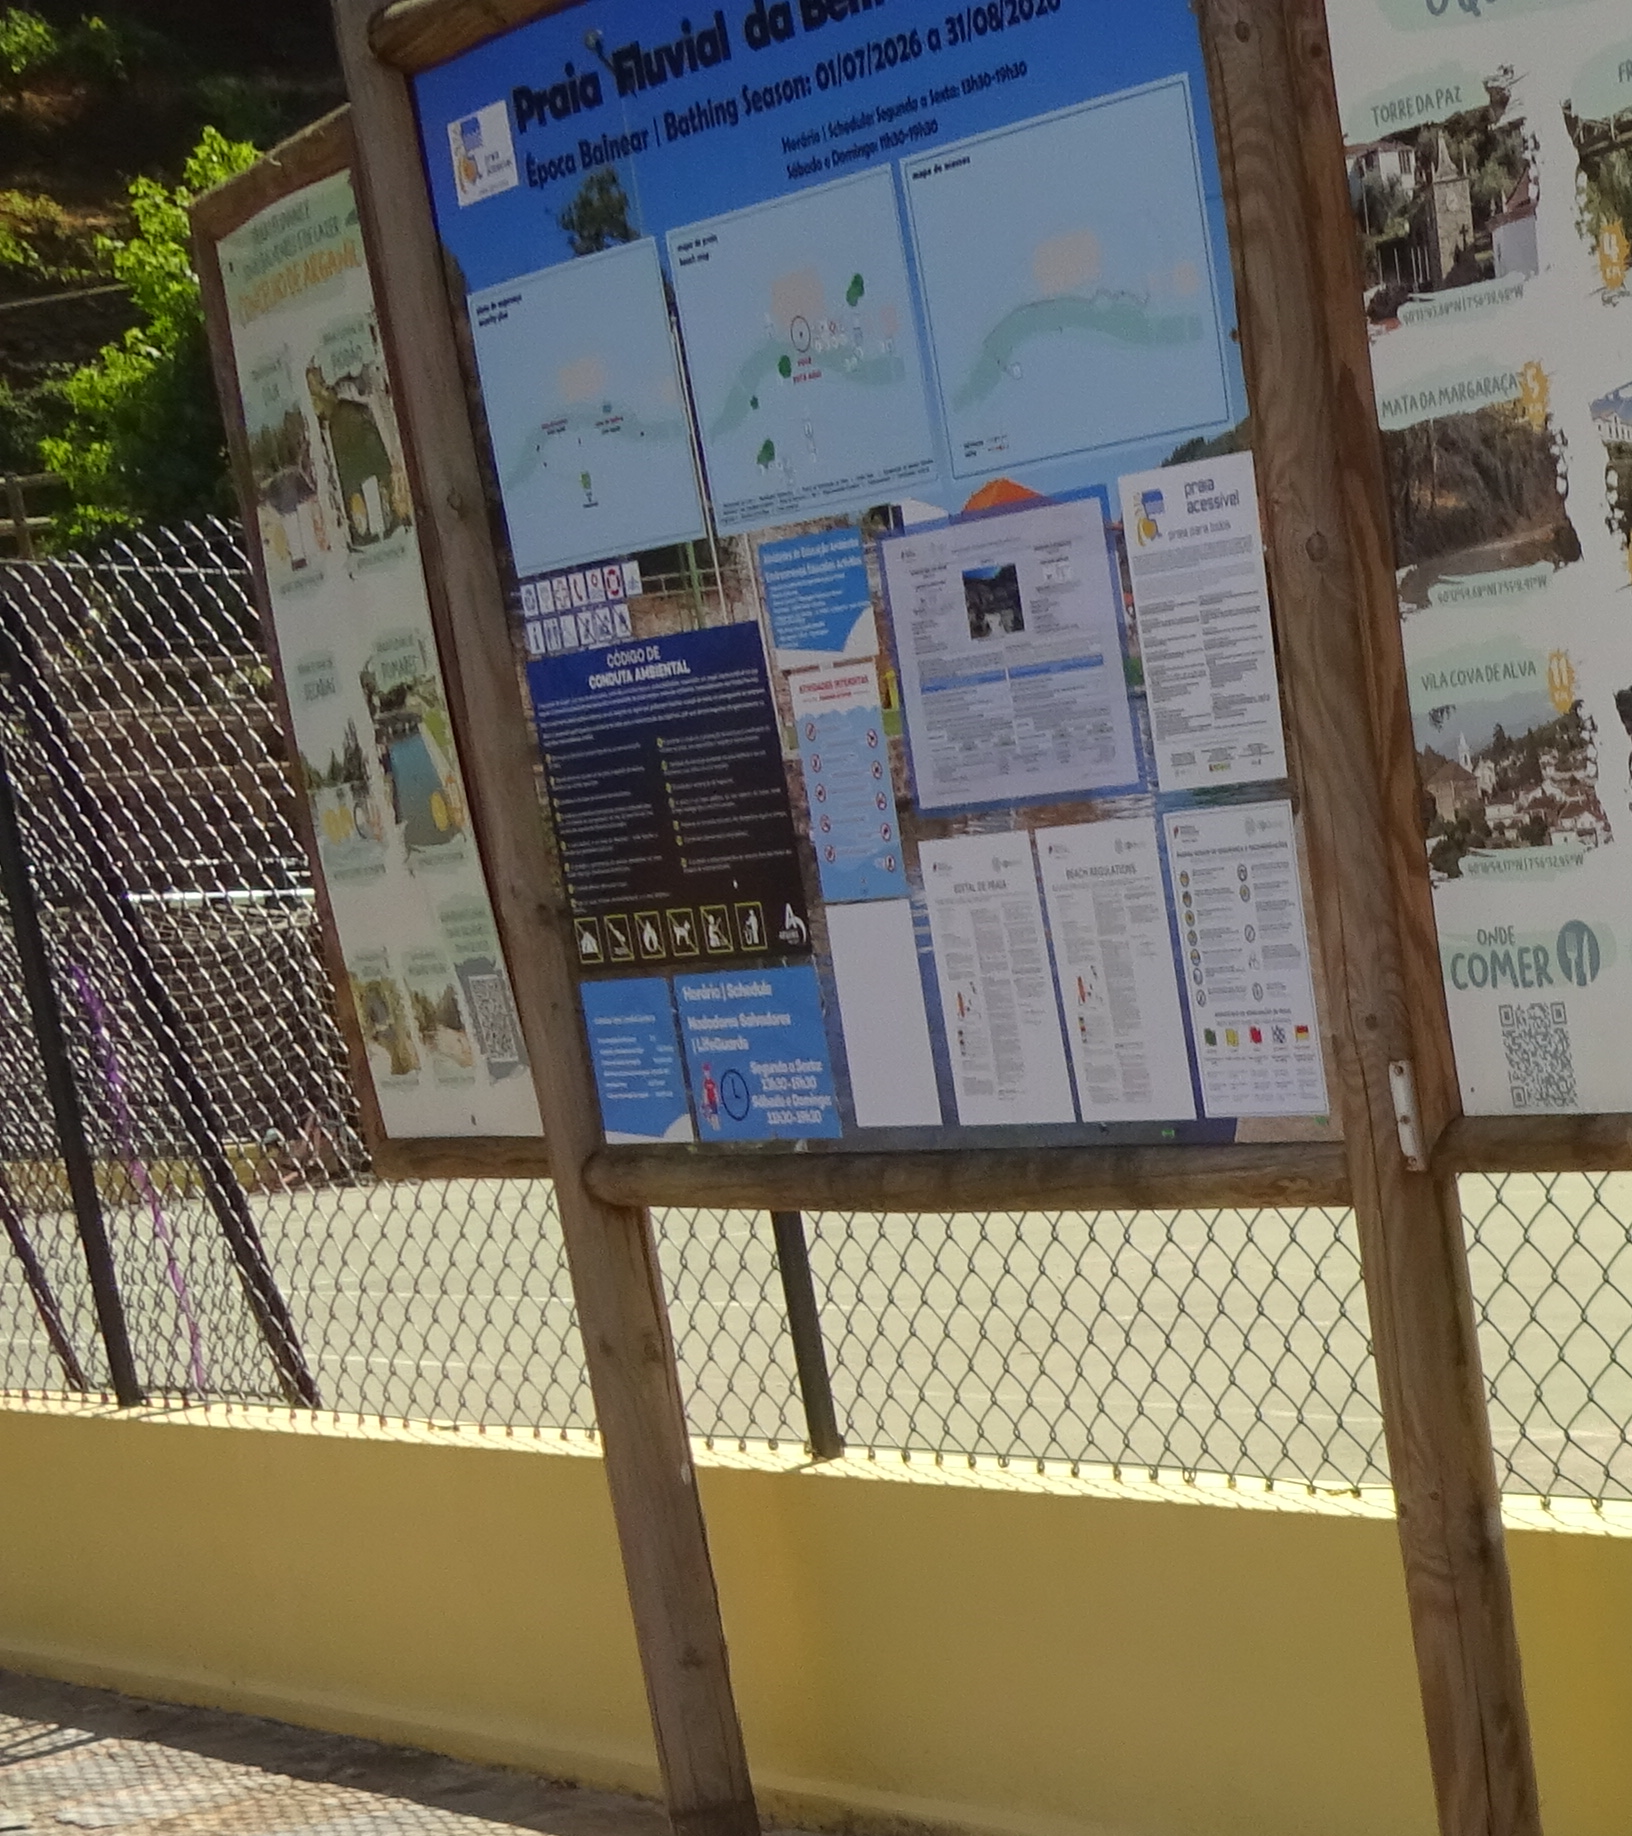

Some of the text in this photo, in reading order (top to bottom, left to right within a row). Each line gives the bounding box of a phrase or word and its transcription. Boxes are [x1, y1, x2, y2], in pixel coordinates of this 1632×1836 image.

[511, 62, 603, 133] Praia
[612, 10, 731, 97] Fluvial
[744, 0, 796, 51] da
[526, 152, 576, 190] Época
[578, 127, 650, 169] Balnear
[663, 98, 740, 141] Bathing
[741, 75, 812, 114] Season:
[815, 28, 923, 92] 01/07/2026
[927, 28, 942, 51] a
[1371, 86, 1463, 127] TORRE DA PAZ
[1602, 231, 1620, 262] 4
[1381, 372, 1519, 418] MATA DA MARGARAÇA
[1184, 478, 1215, 499] praia
[1187, 489, 1240, 514] acessível
[646, 645, 661, 662] DE
[1450, 666, 1484, 689] COVA
[1485, 665, 1502, 683] DE
[1502, 660, 1537, 682] ALVA
[1476, 925, 1515, 947] ONDE
[1450, 944, 1554, 991] COMER
